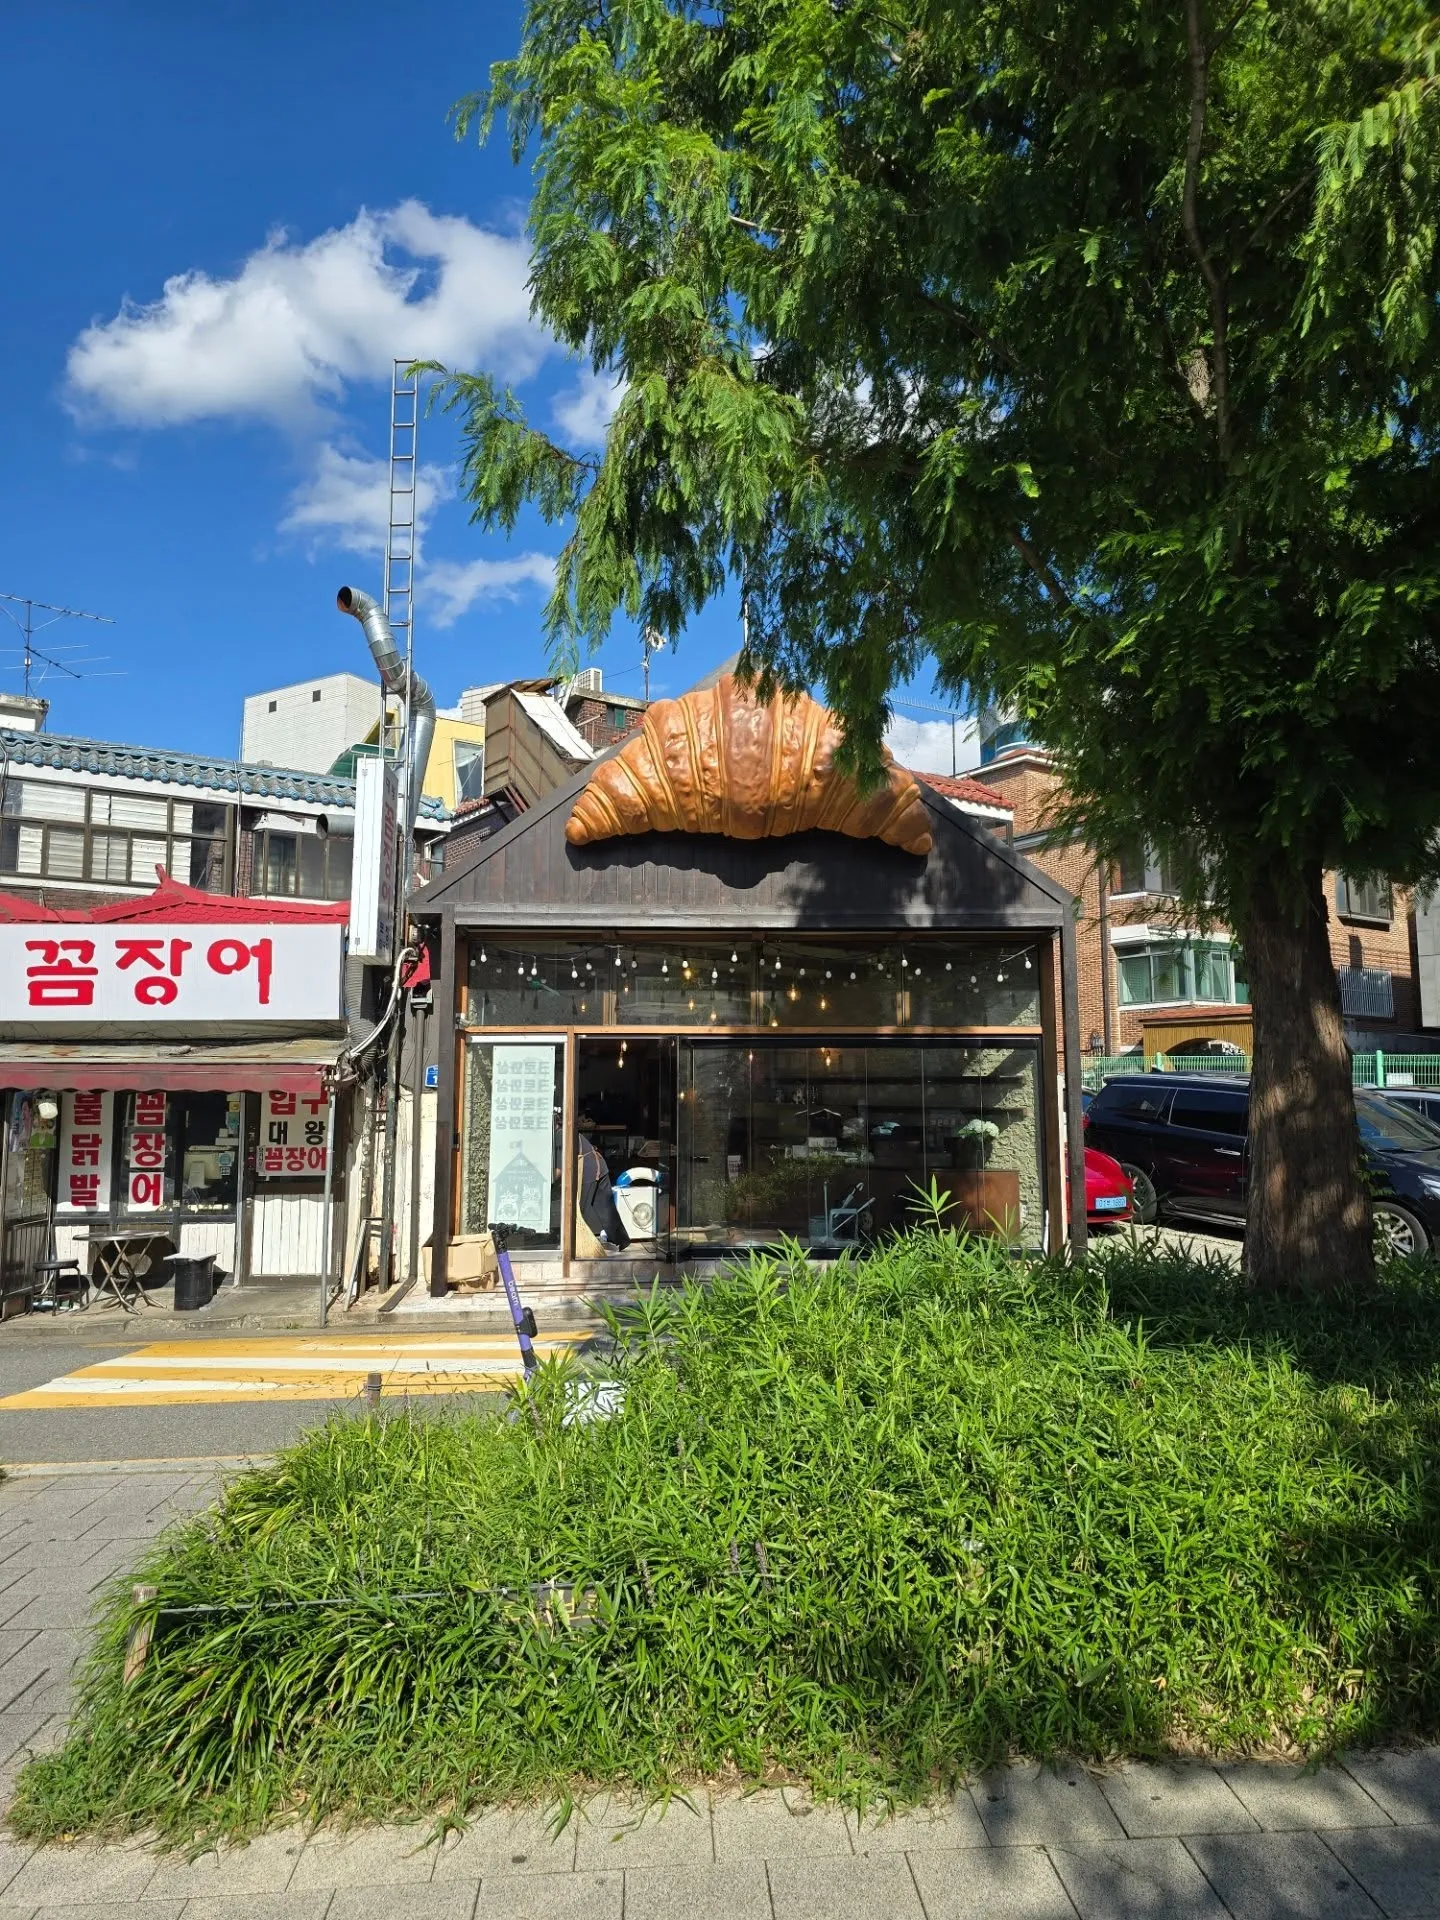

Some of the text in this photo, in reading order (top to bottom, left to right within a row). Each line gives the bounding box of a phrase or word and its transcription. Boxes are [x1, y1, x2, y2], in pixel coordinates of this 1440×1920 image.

[25, 938, 273, 1006] 꼼장어
[69, 1093, 102, 1207] 불닭발
[131, 1092, 165, 1207] 꼼장어
[265, 1146, 328, 1172] 꼼장어
[269, 1120, 326, 1145] 대왕
